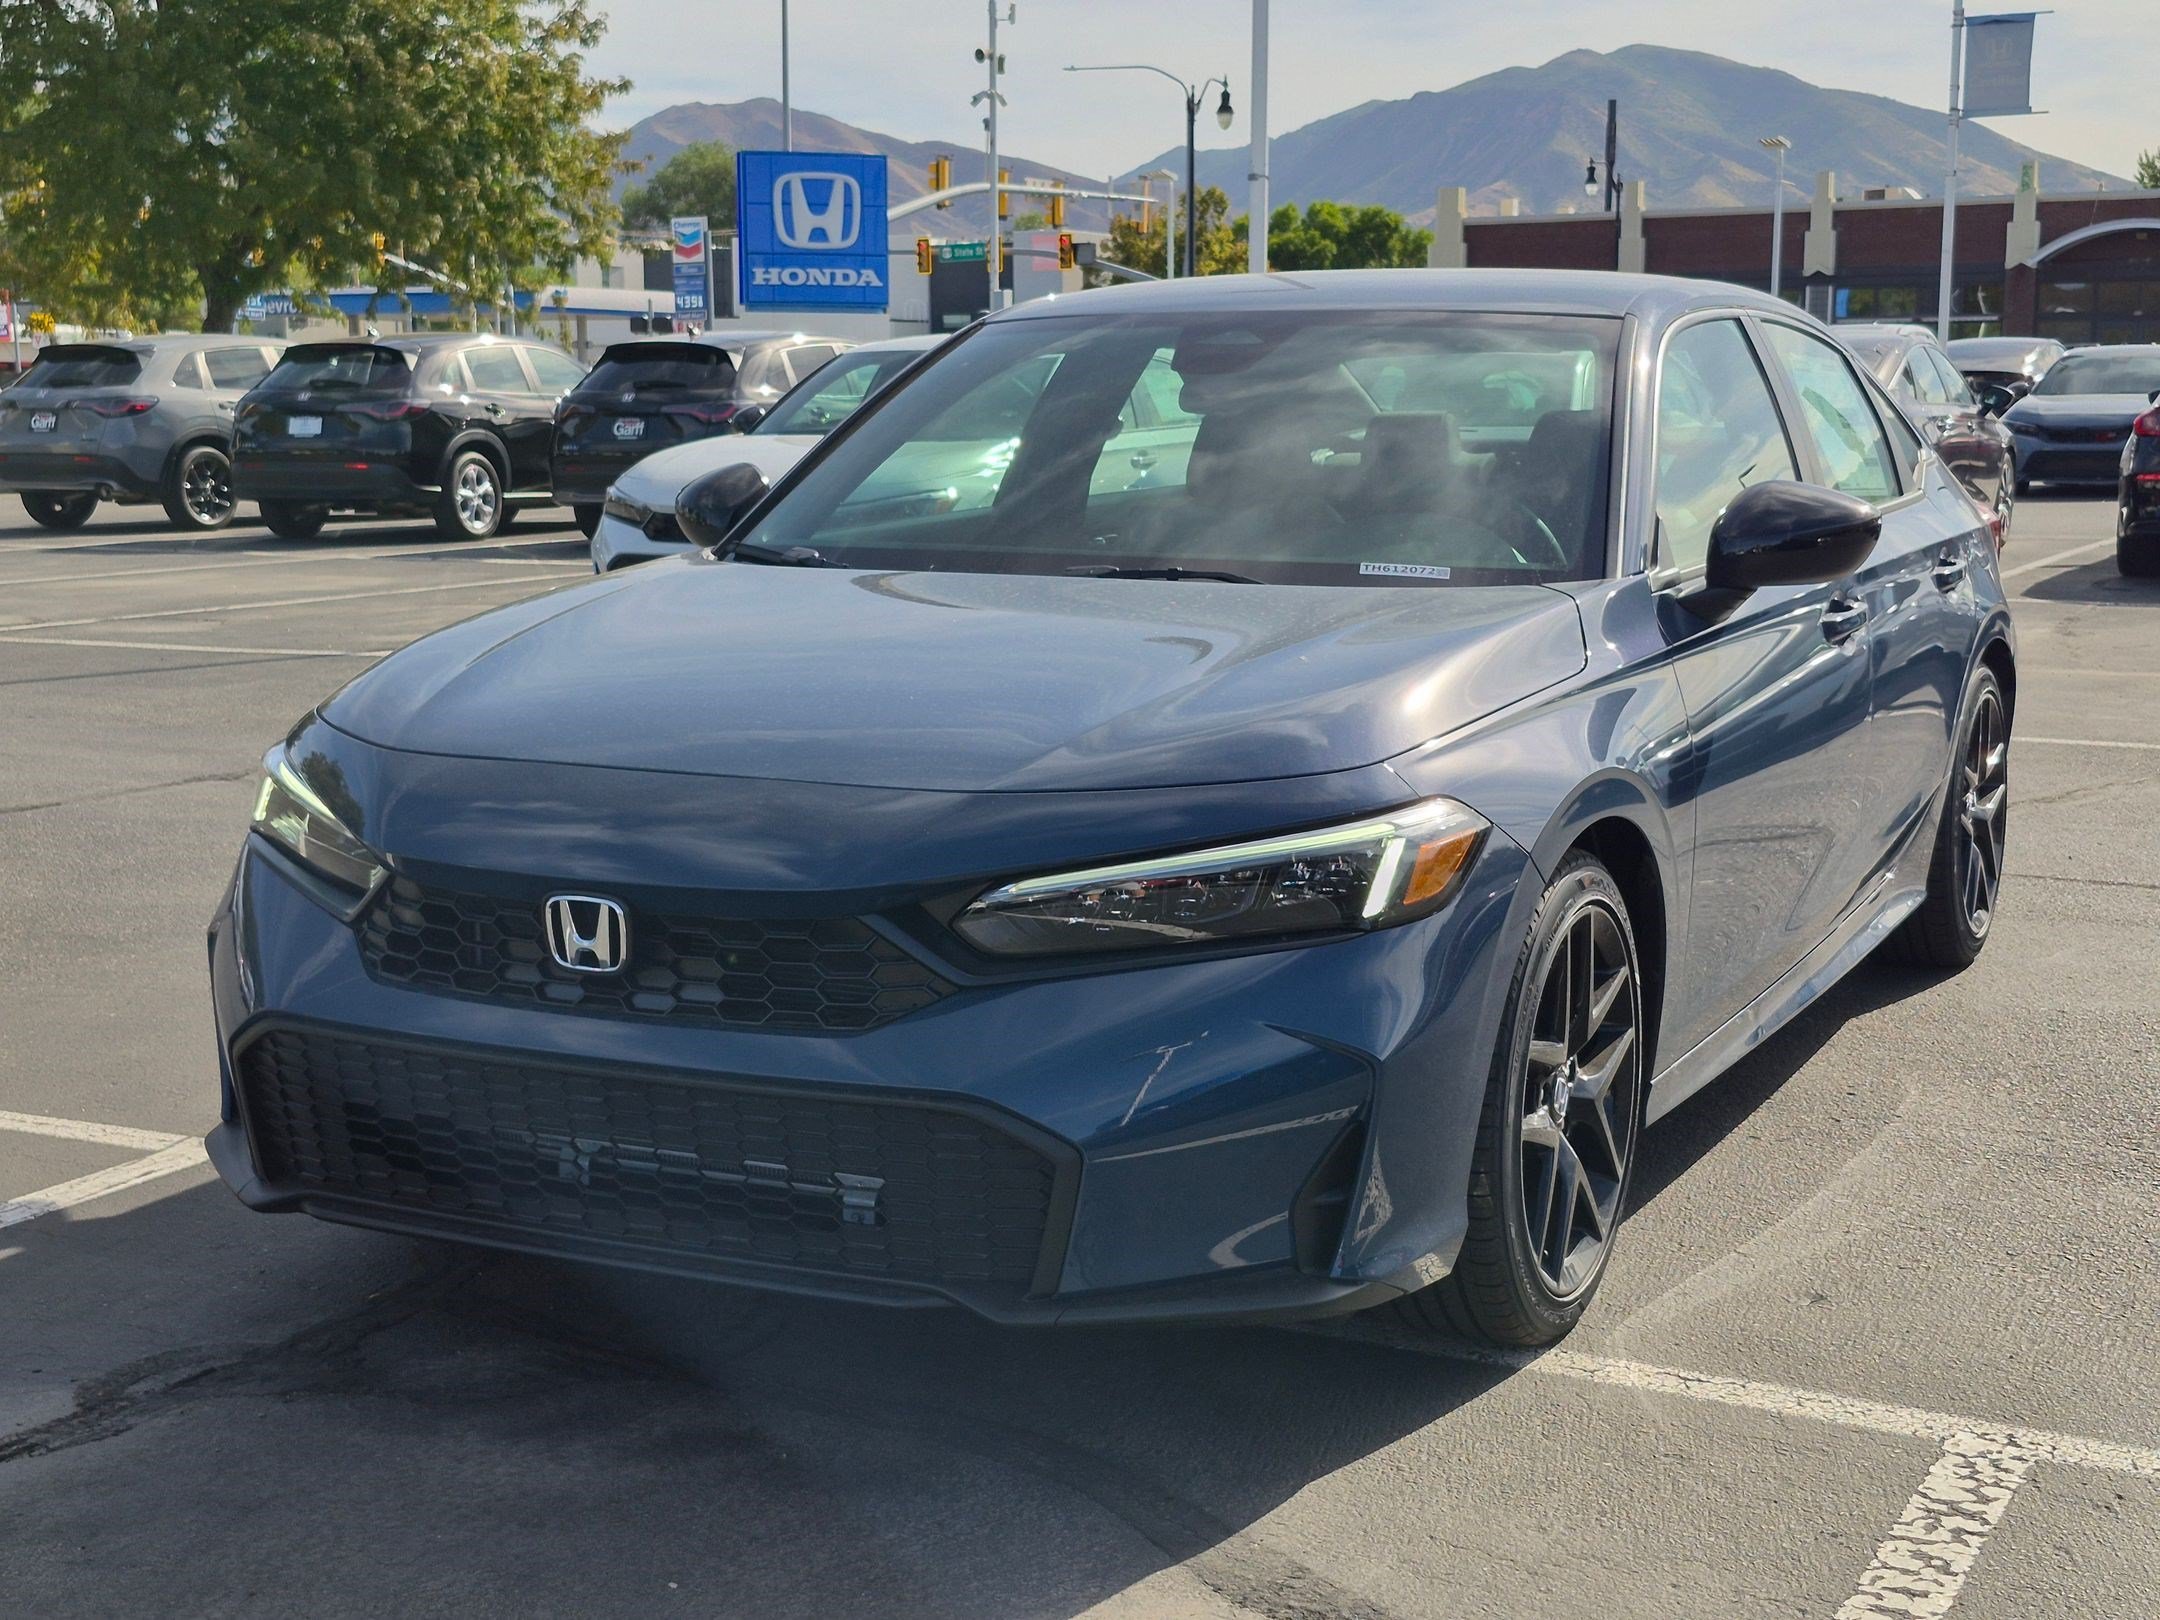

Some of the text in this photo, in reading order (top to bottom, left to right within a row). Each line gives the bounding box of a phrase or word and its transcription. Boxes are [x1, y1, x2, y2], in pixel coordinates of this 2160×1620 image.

[954, 248, 973, 257] State
[752, 268, 883, 287] HONDA
[613, 420, 645, 436] Garff
[1363, 564, 1436, 575] TH612072
